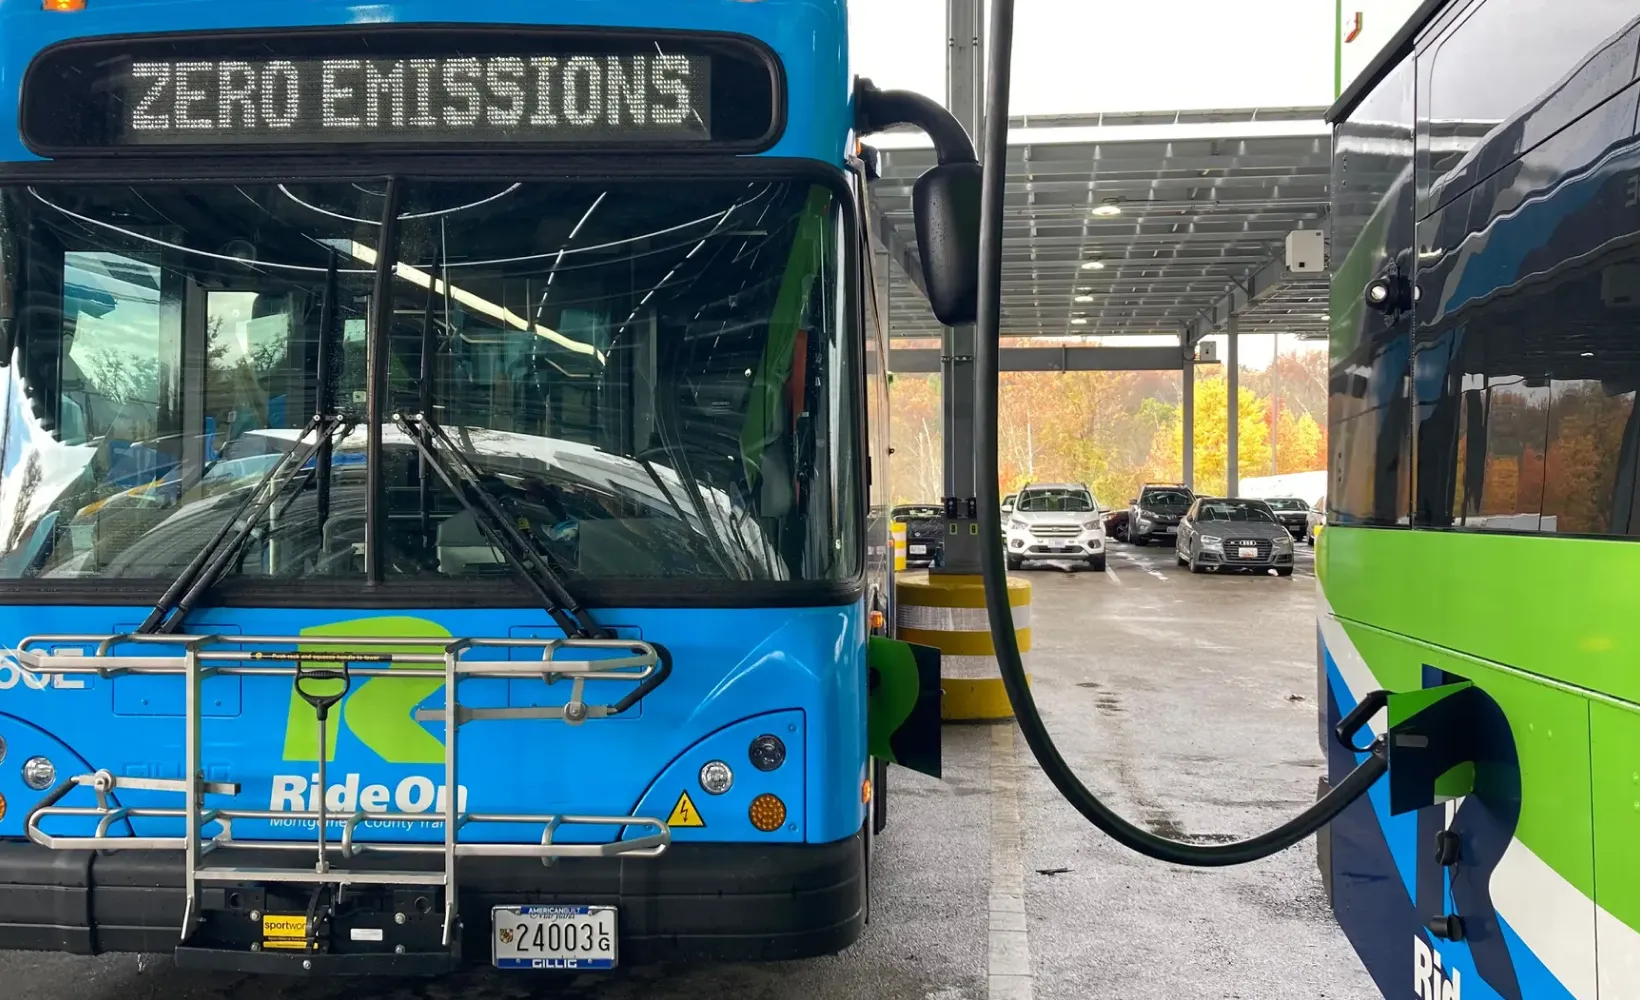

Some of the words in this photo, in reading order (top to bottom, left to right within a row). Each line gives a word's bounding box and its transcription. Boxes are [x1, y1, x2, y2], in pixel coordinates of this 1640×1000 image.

[132, 60, 299, 129] ZERO
[322, 55, 691, 127] EMISSIONS
[270, 818, 358, 830] Montgme
[364, 819, 413, 831] County
[264, 921, 306, 930] sportwor
[516, 923, 593, 952] 24003
[532, 958, 578, 969] GILLIG
